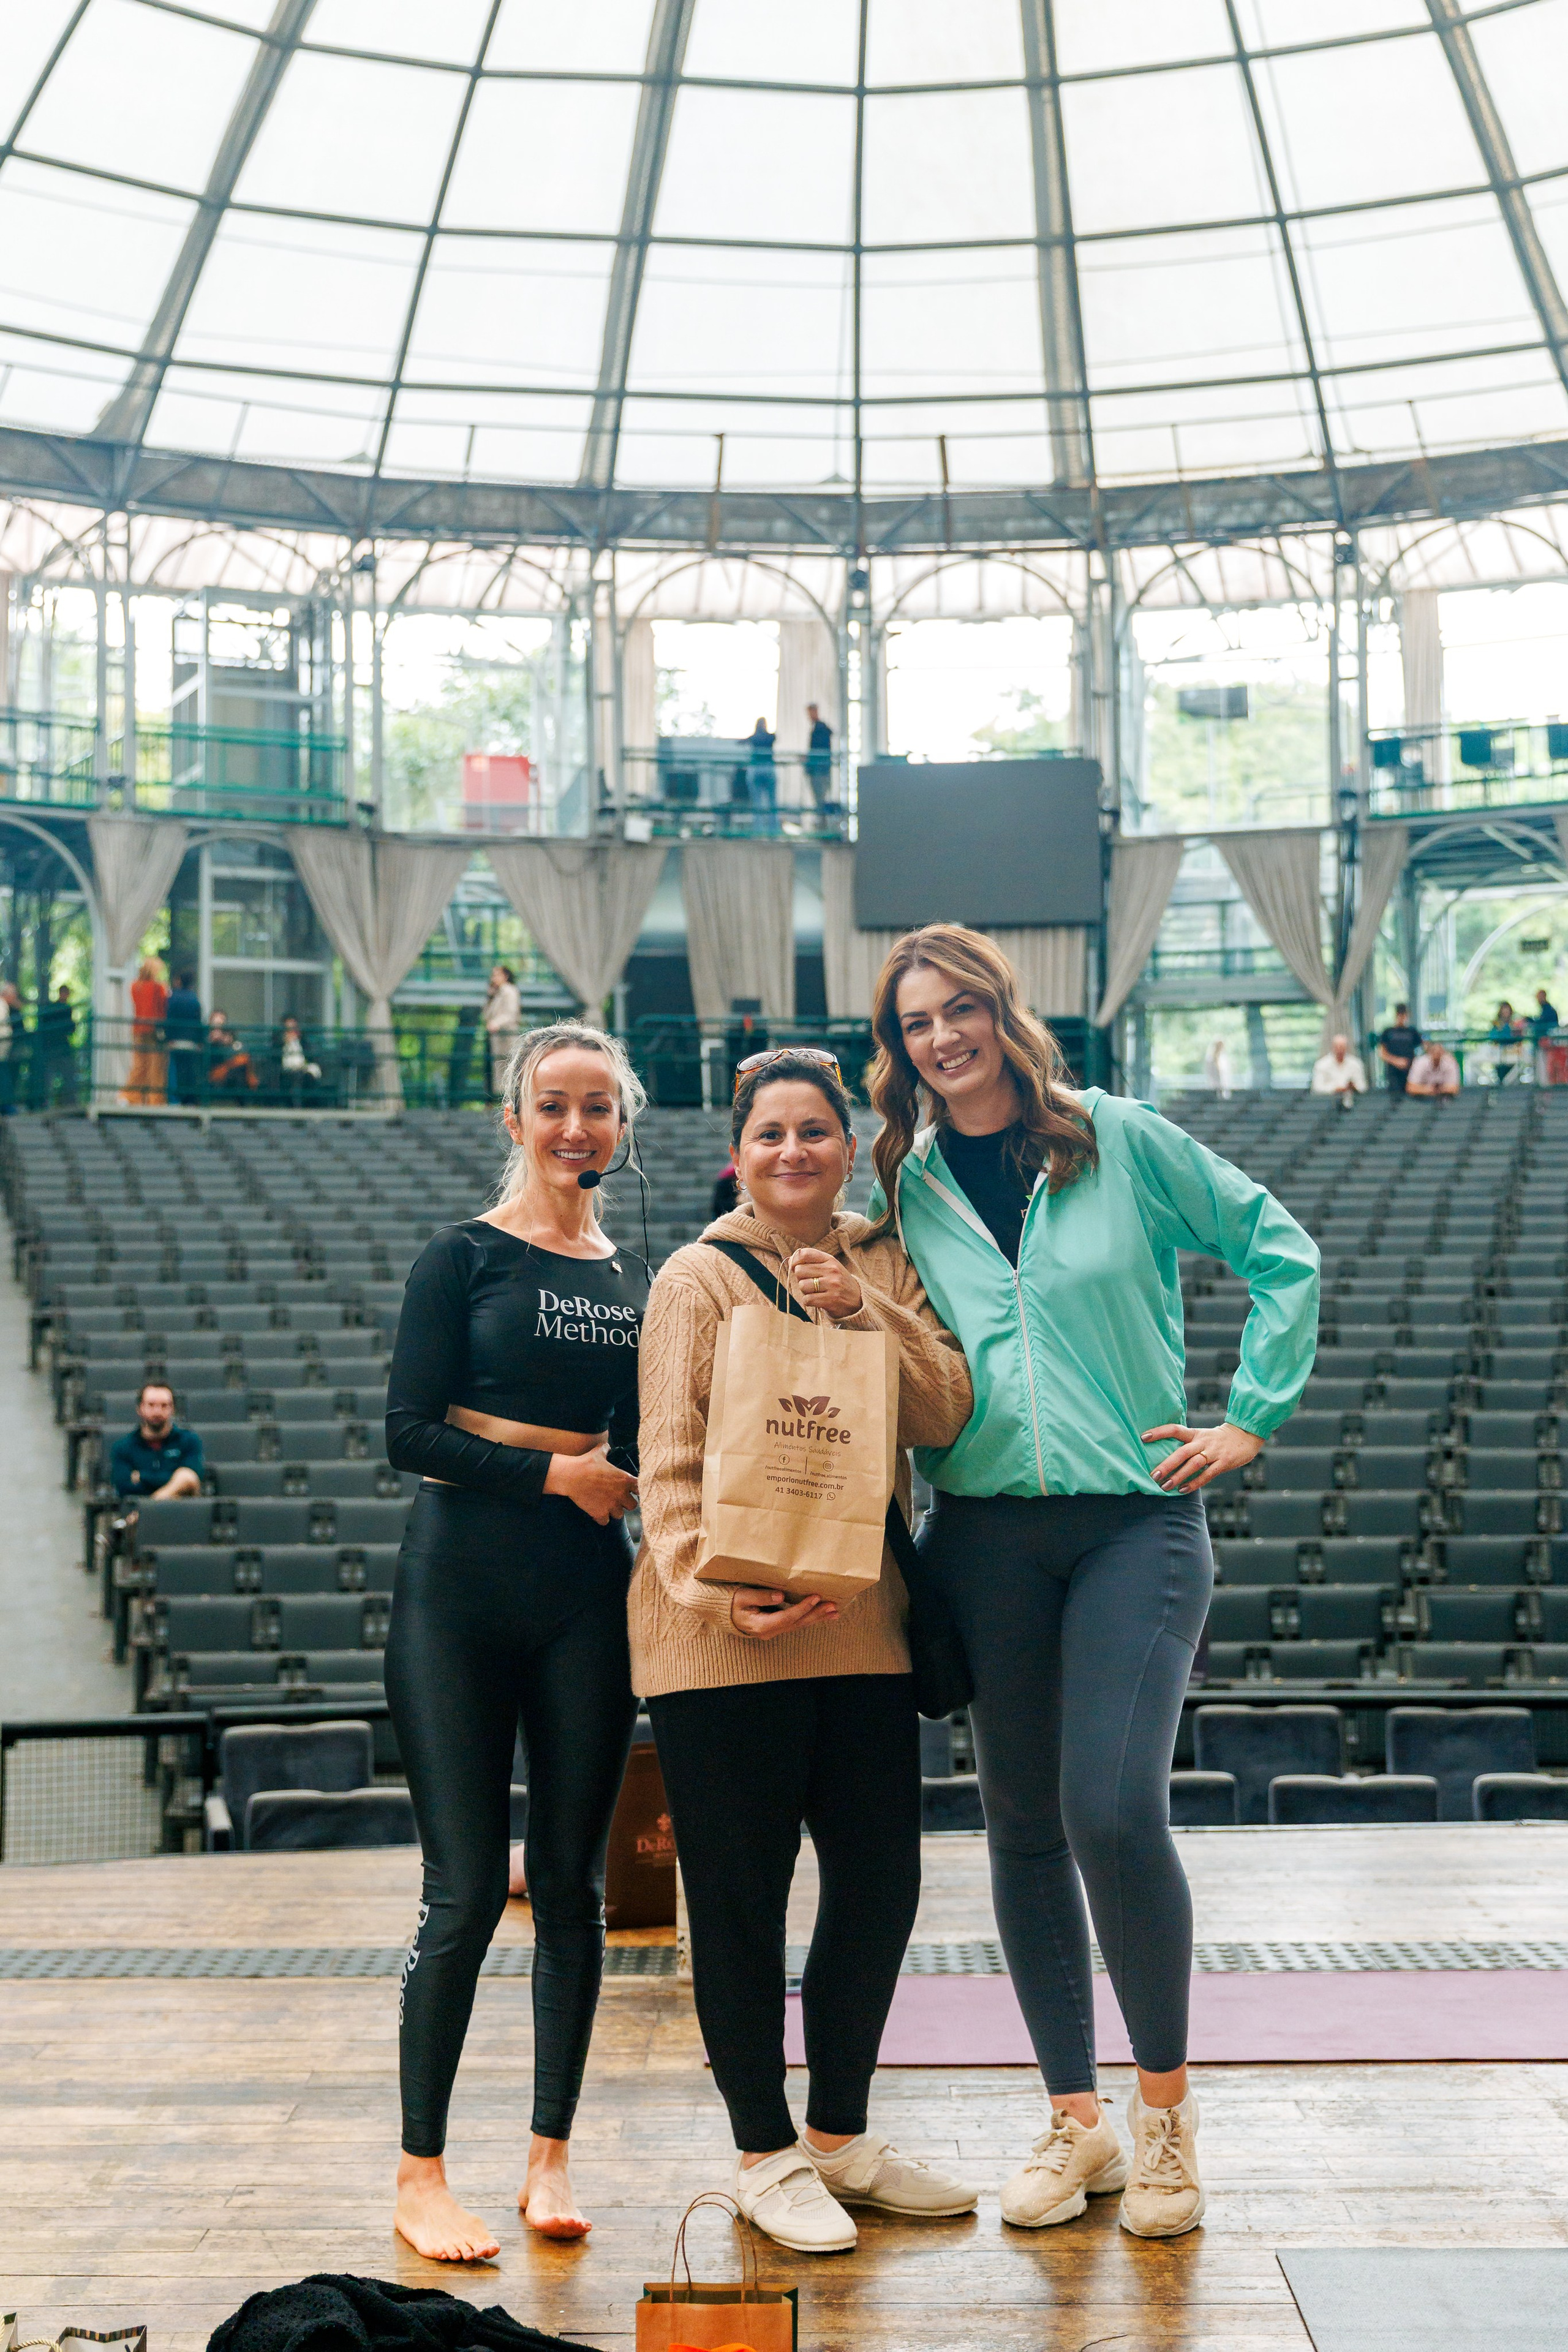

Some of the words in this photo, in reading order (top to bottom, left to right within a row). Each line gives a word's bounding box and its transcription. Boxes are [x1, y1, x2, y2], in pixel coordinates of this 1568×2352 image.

[538, 1289, 637, 1322] DeRose
[533, 1312, 641, 1348] Method
[766, 1418, 851, 1444] nutfree
[774, 1441, 807, 1452] Alimentos
[809, 1446, 842, 1457] Saudáveis
[766, 1475, 844, 1490] emporionutfree.com.br
[786, 1488, 823, 1499] 3403-6117
